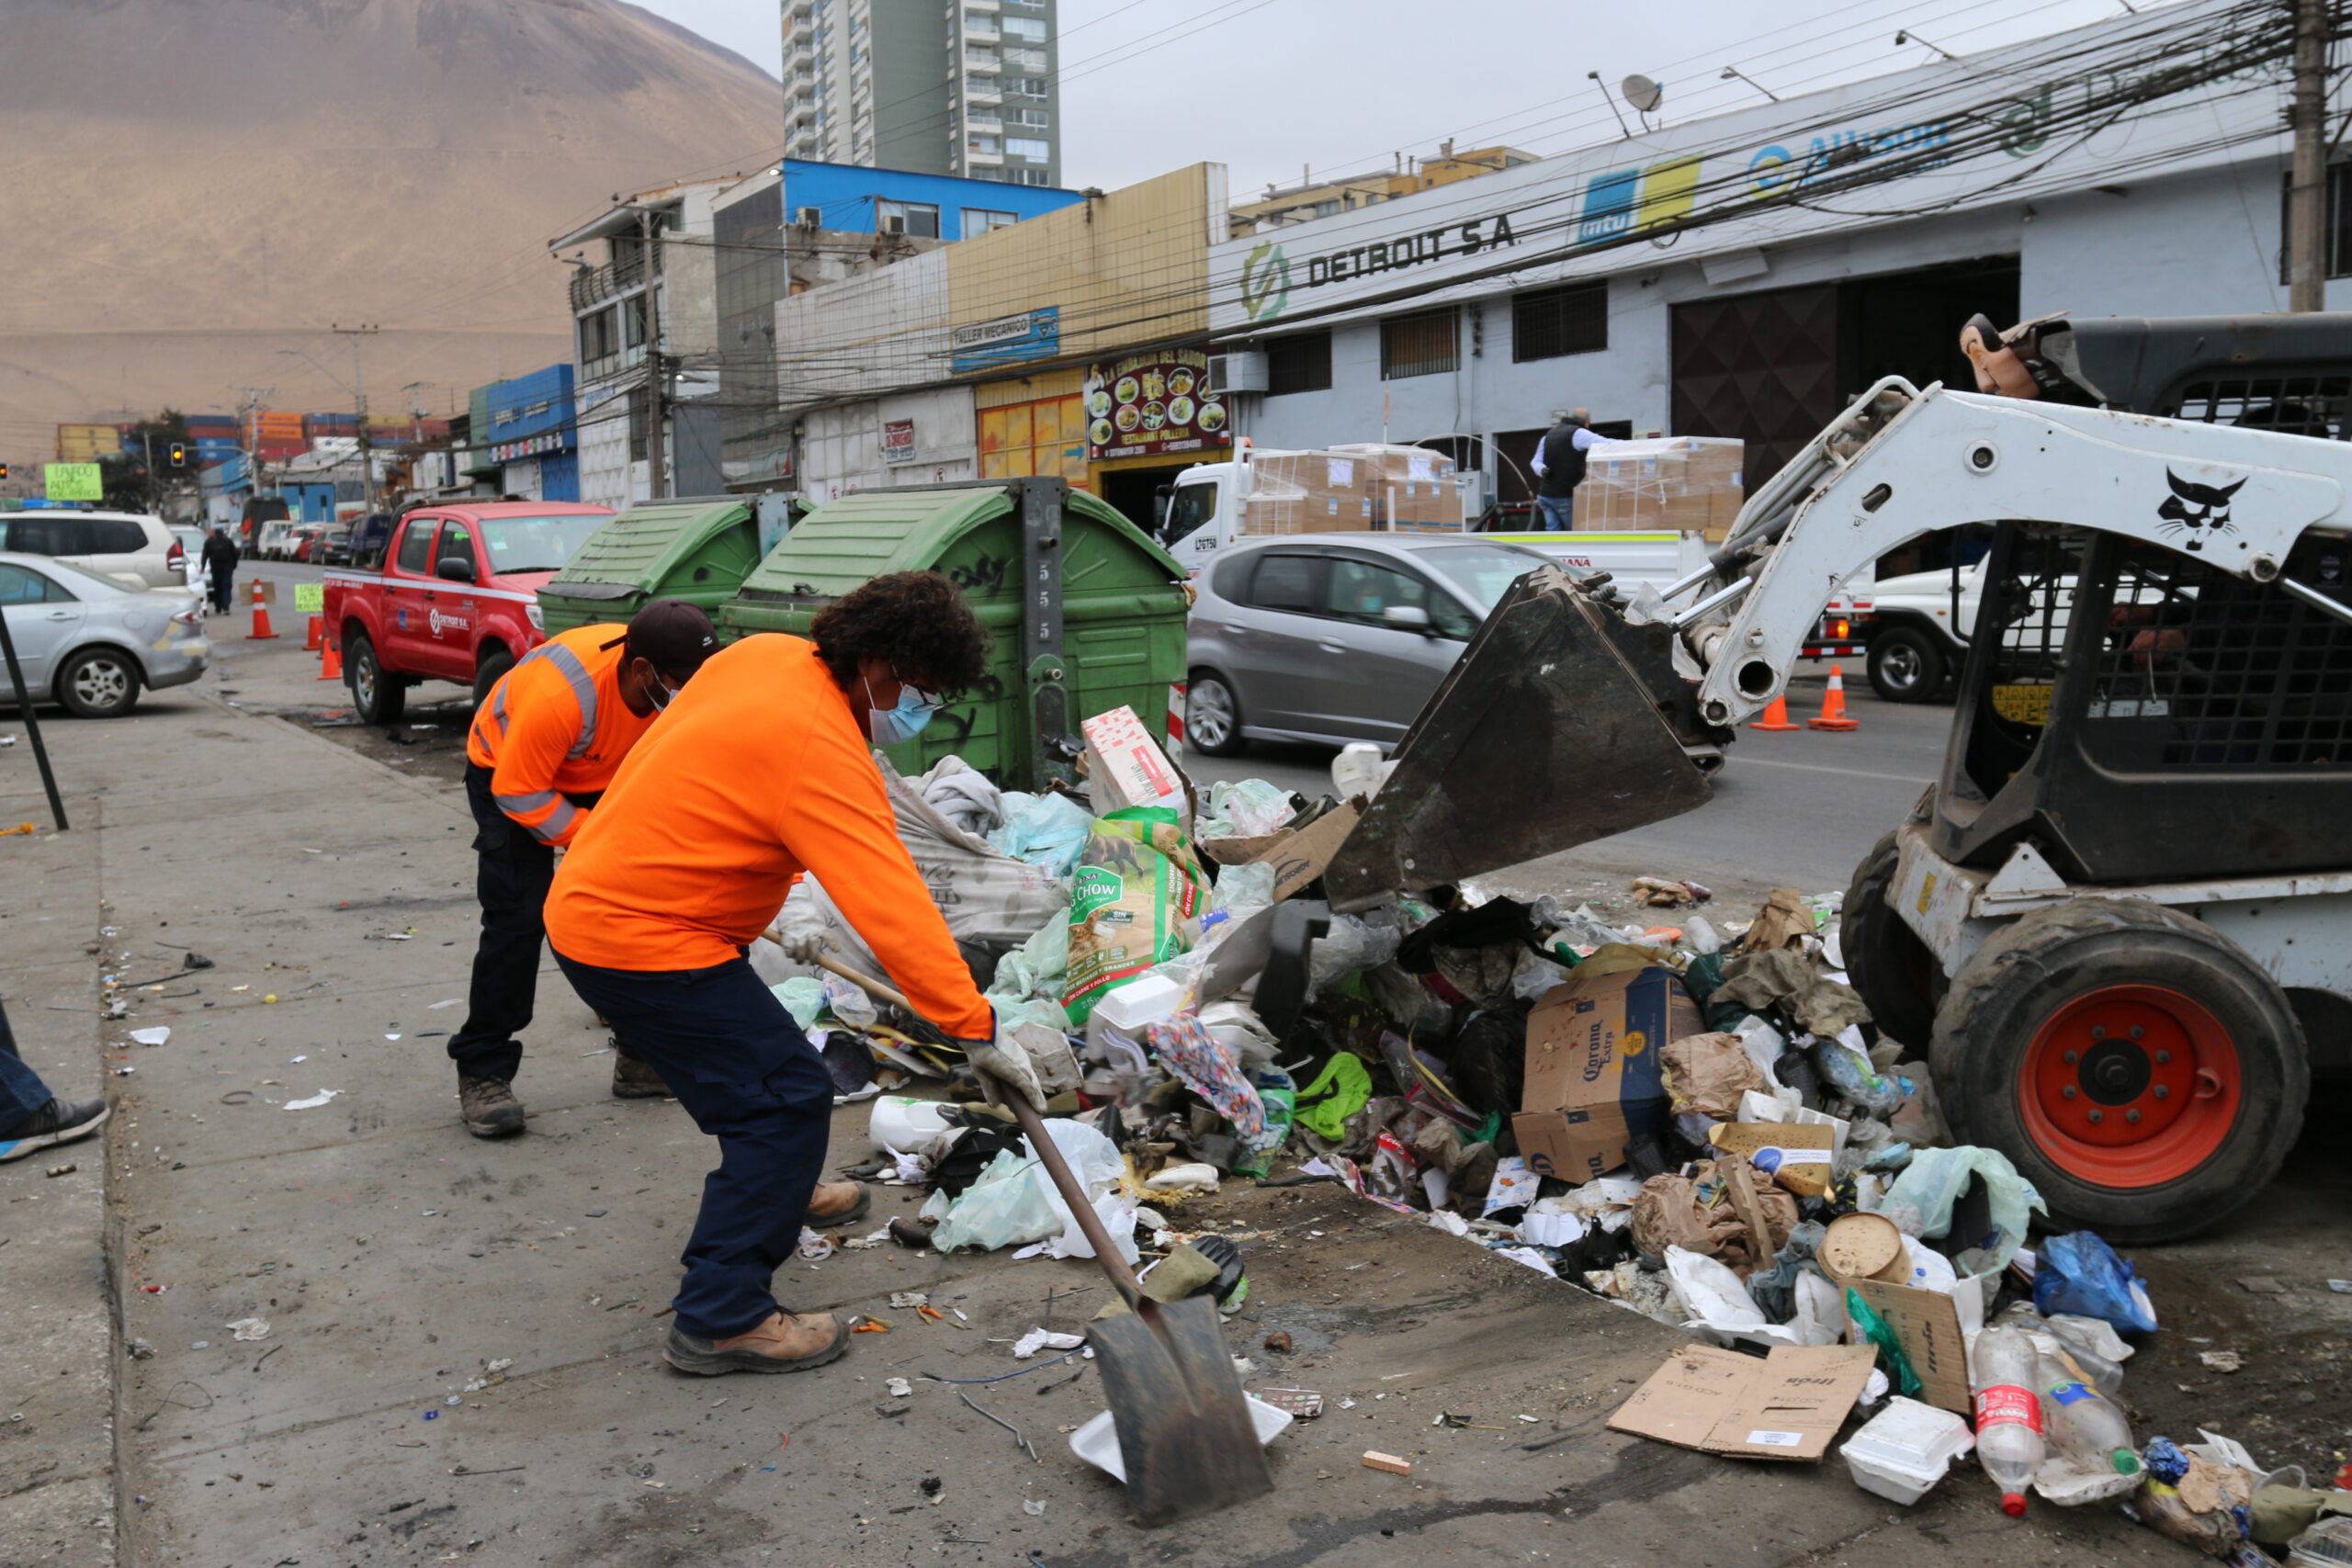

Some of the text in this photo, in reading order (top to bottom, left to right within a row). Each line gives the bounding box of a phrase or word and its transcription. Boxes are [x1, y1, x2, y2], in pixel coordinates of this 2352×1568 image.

[1309, 214, 1522, 288] DETROIT S.A.
[955, 328, 982, 345] TALLER
[1077, 883, 1116, 901] CHOW
[1113, 910, 1127, 919] SIN
[1093, 975, 1111, 987] POLLO
[1582, 1021, 1603, 1083] Corona
[1600, 1031, 1615, 1068] Extra
